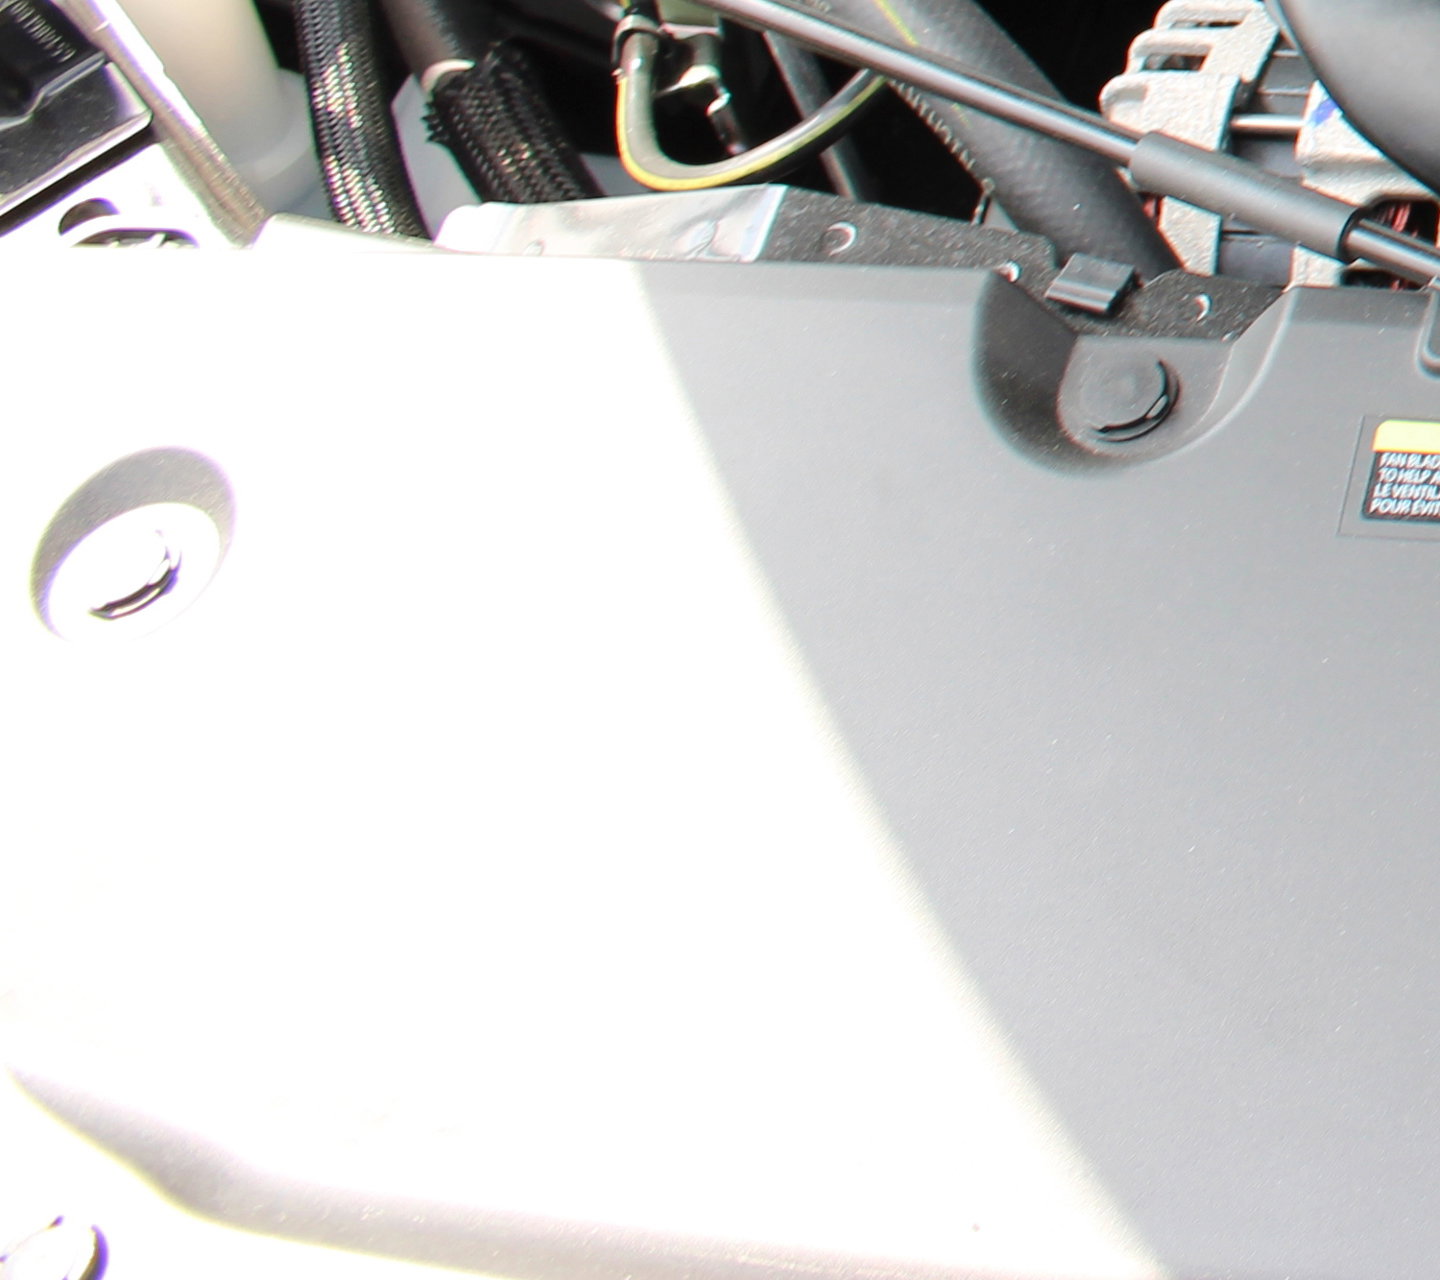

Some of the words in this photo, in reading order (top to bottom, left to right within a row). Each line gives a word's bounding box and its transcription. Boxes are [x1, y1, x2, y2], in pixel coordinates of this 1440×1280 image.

[1380, 452, 1408, 468] FAN
[1378, 467, 1398, 482] TO
[1397, 468, 1431, 484] HELP
[1373, 482, 1392, 498] LE
[1370, 497, 1412, 514] POUR
